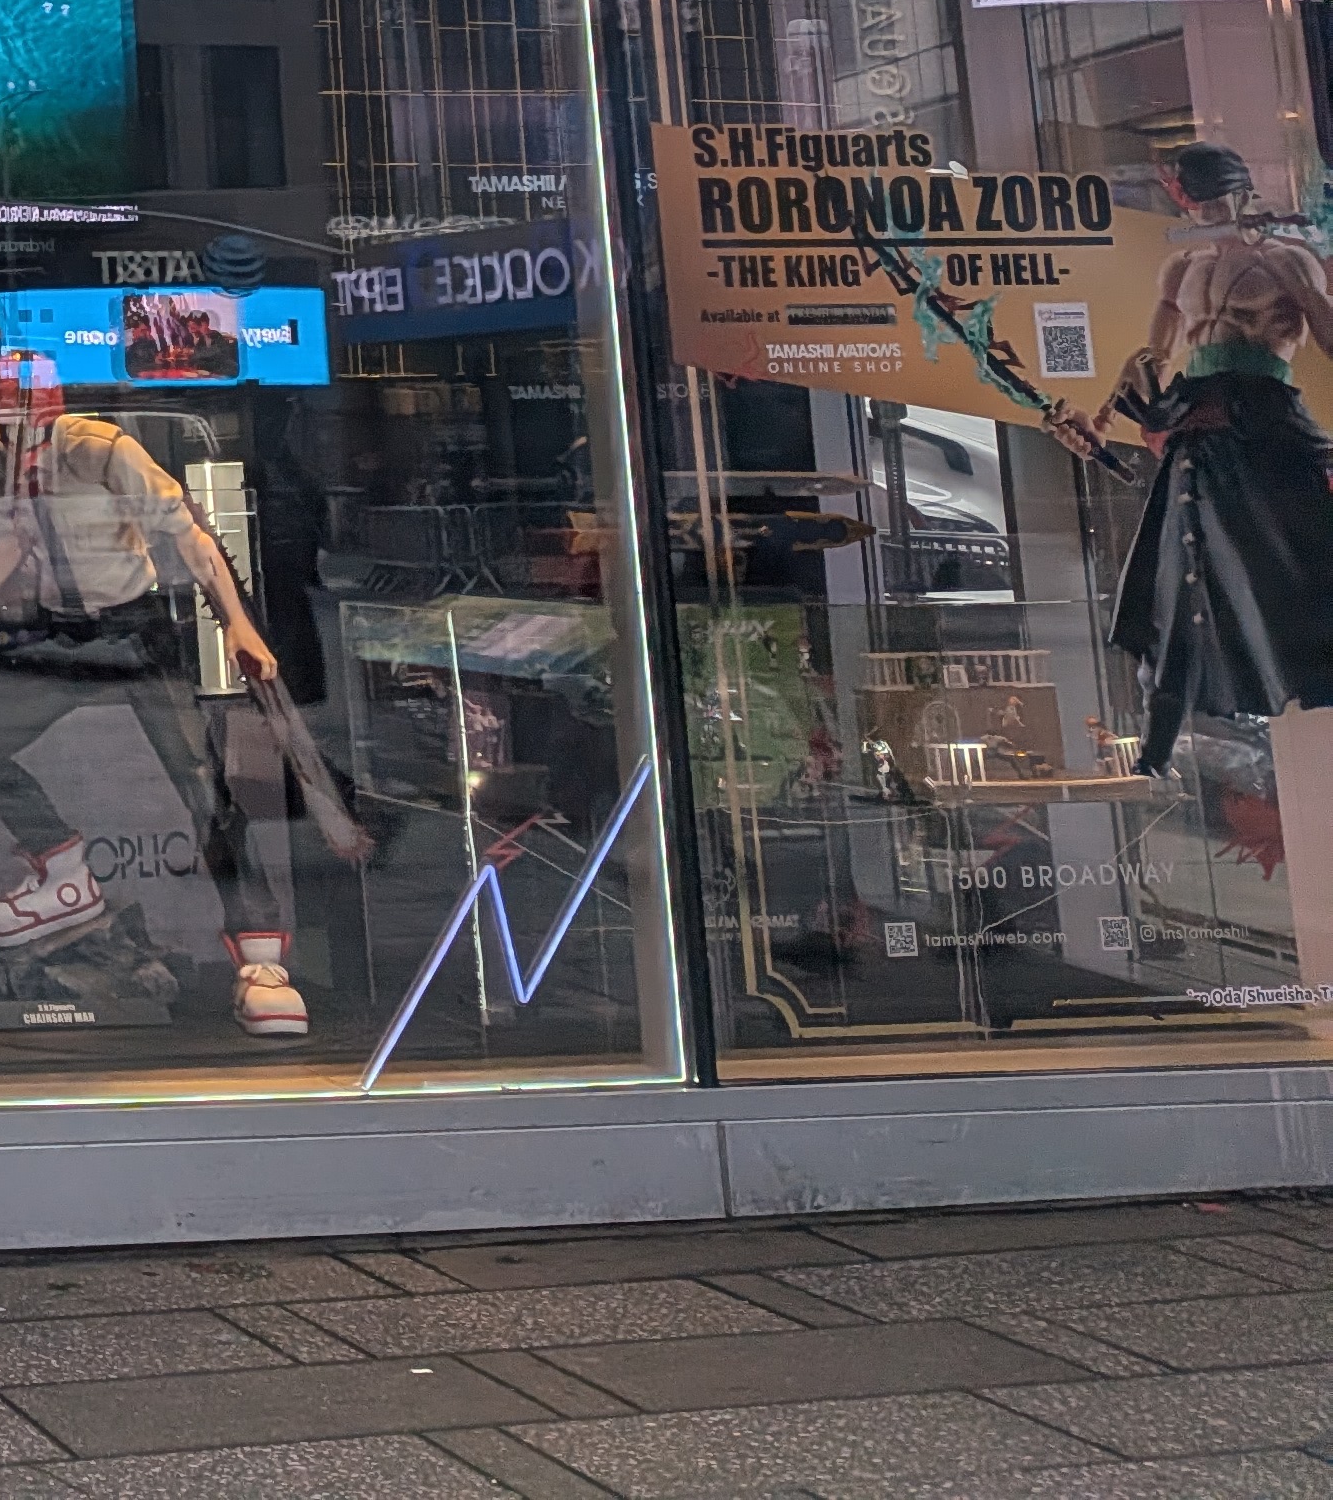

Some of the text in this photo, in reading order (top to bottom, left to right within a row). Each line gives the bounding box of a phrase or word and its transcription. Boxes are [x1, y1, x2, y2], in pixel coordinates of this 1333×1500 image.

[693, 126, 932, 172] S.H.Figuarts
[468, 174, 556, 193] TAMASHII
[701, 174, 969, 235] RORONOA
[974, 174, 1112, 233] ZORO
[783, 254, 861, 288] KING
[947, 256, 985, 287] OF
[700, 308, 762, 324] Available
[765, 309, 780, 323] at
[766, 342, 902, 360] TAMASHII NATIONS
[767, 360, 903, 375] ONLINE SHOP
[1020, 861, 1175, 889] BROADWAY
[23, 1011, 96, 1025] CHAINSAW MAN
